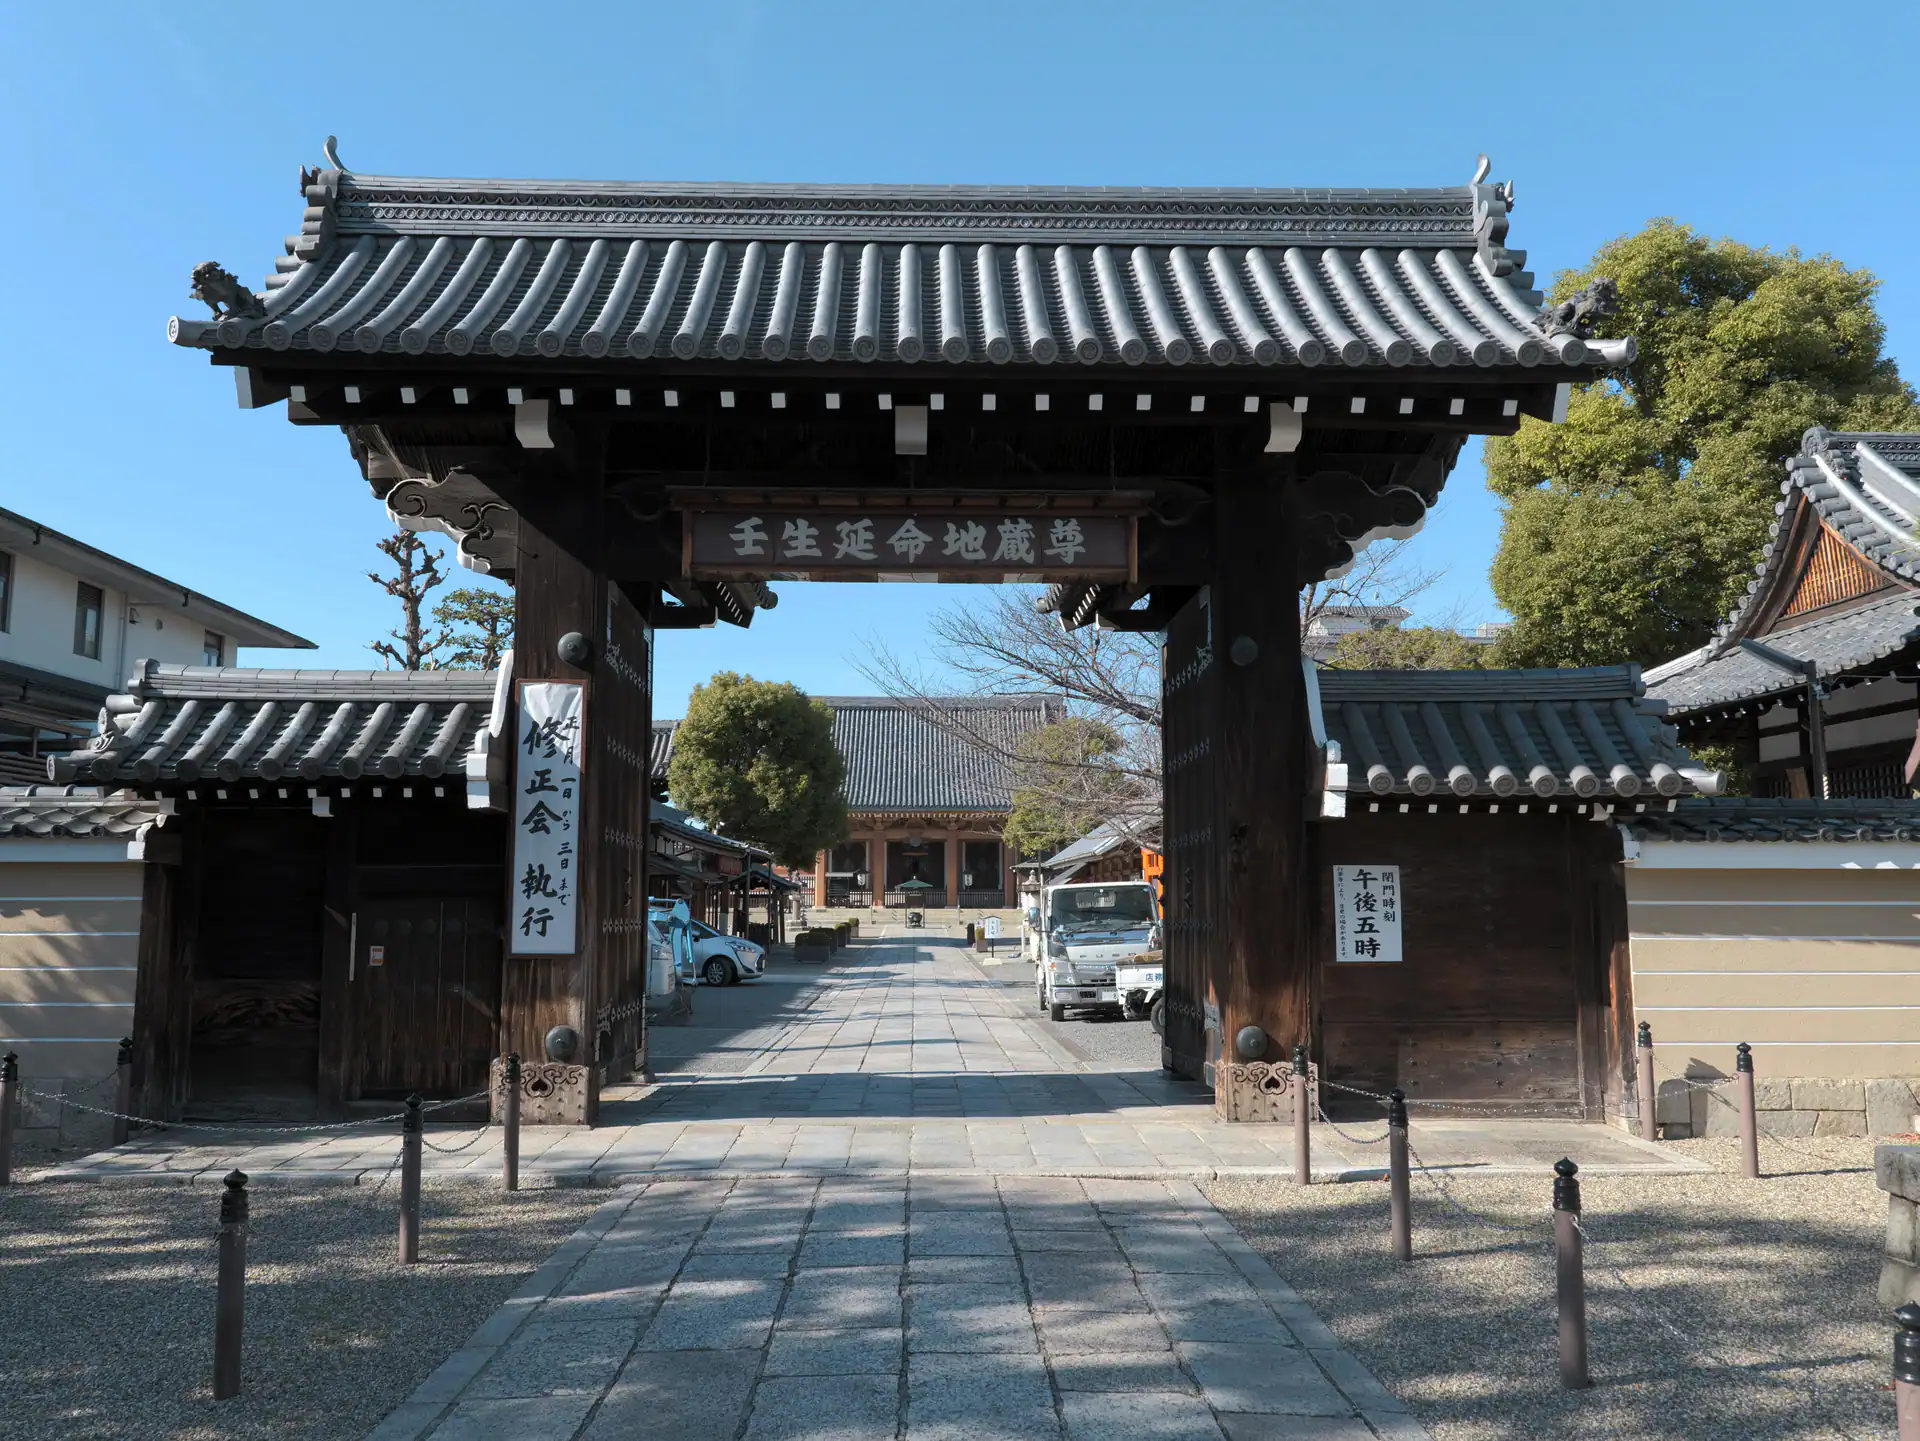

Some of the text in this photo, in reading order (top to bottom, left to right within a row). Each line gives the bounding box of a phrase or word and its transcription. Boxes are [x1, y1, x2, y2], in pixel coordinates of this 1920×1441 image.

[728, 515, 1087, 564] 壬生延命地蔵尊
[1352, 868, 1381, 958] 午後五時
[1381, 871, 1396, 923] 閉門時刻
